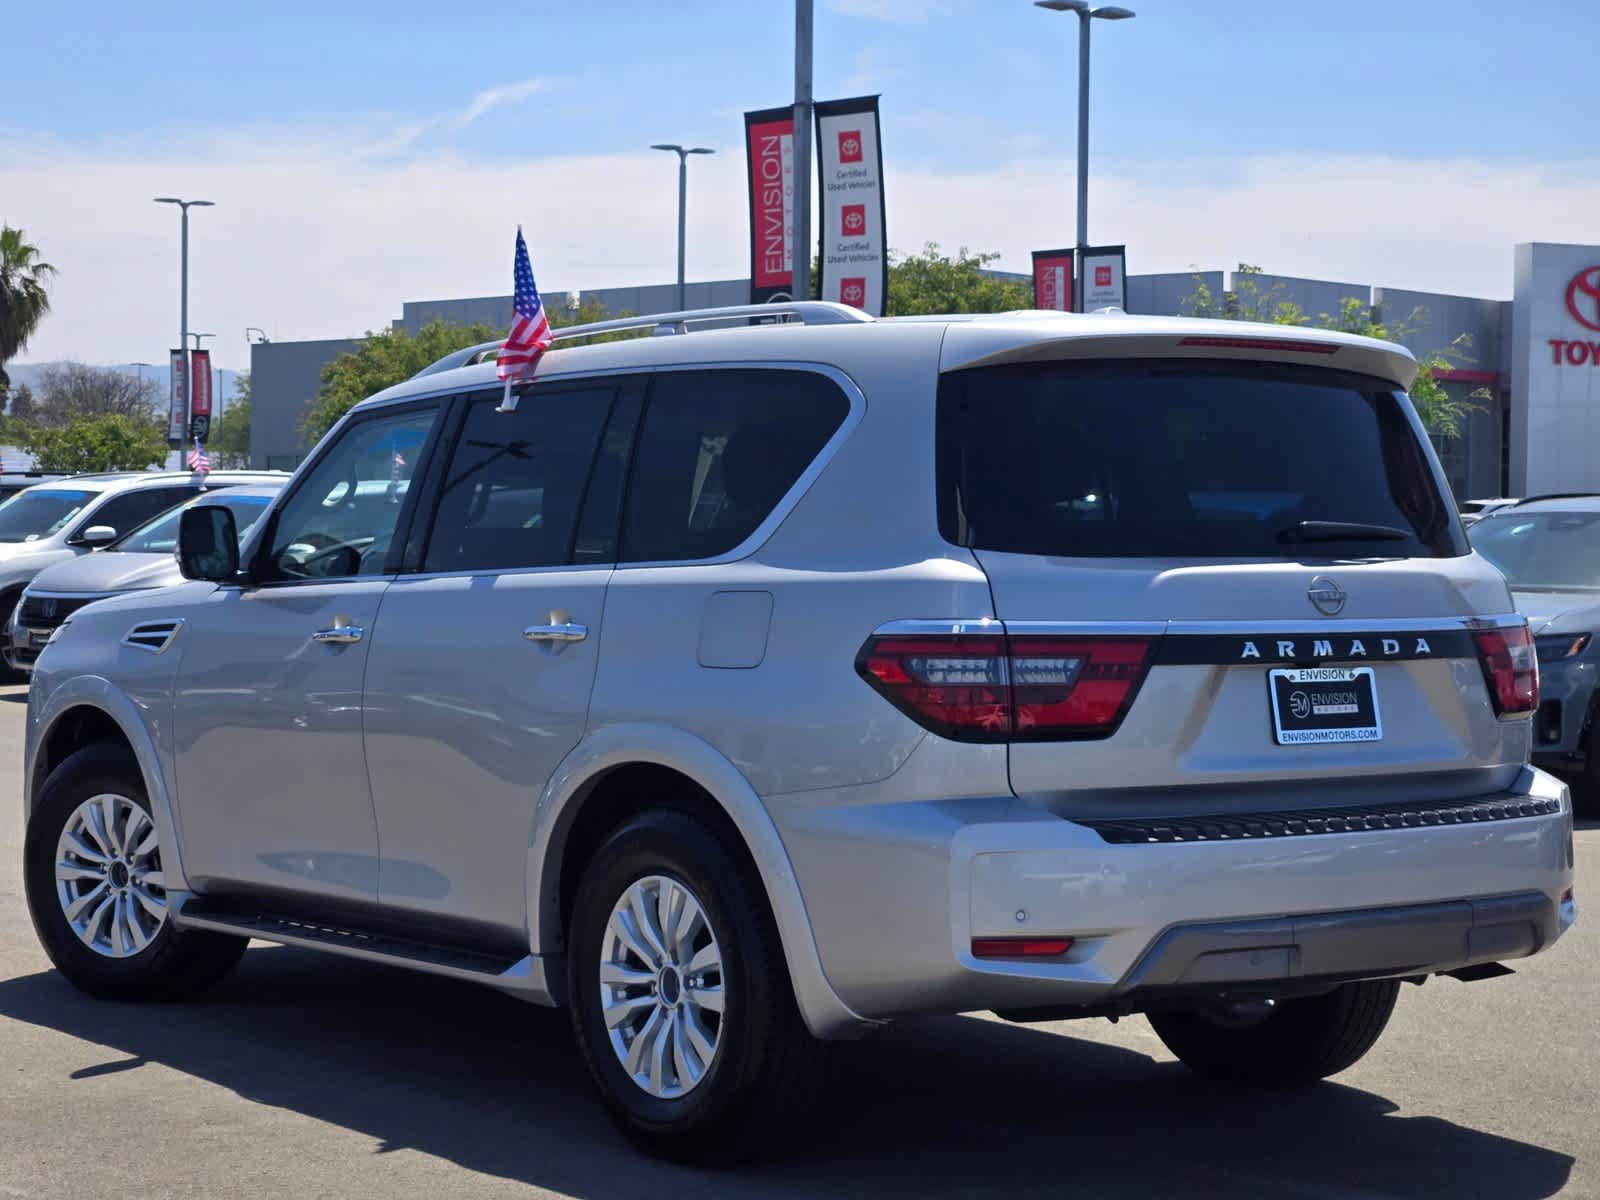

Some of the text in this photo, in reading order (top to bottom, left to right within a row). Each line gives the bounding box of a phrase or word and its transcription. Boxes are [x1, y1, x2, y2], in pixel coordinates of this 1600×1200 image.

[827, 182, 847, 191] Used
[760, 135, 784, 273] ENVISION
[838, 241, 870, 252] Certified
[827, 253, 879, 264] Used Vehicles
[1041, 266, 1056, 310] SION
[1240, 637, 1432, 658] ARMADA
[1299, 669, 1345, 681] ENVISION
[1311, 692, 1358, 705] ENVISION
[1282, 729, 1378, 743] ENVISIONMOTORS.COM
